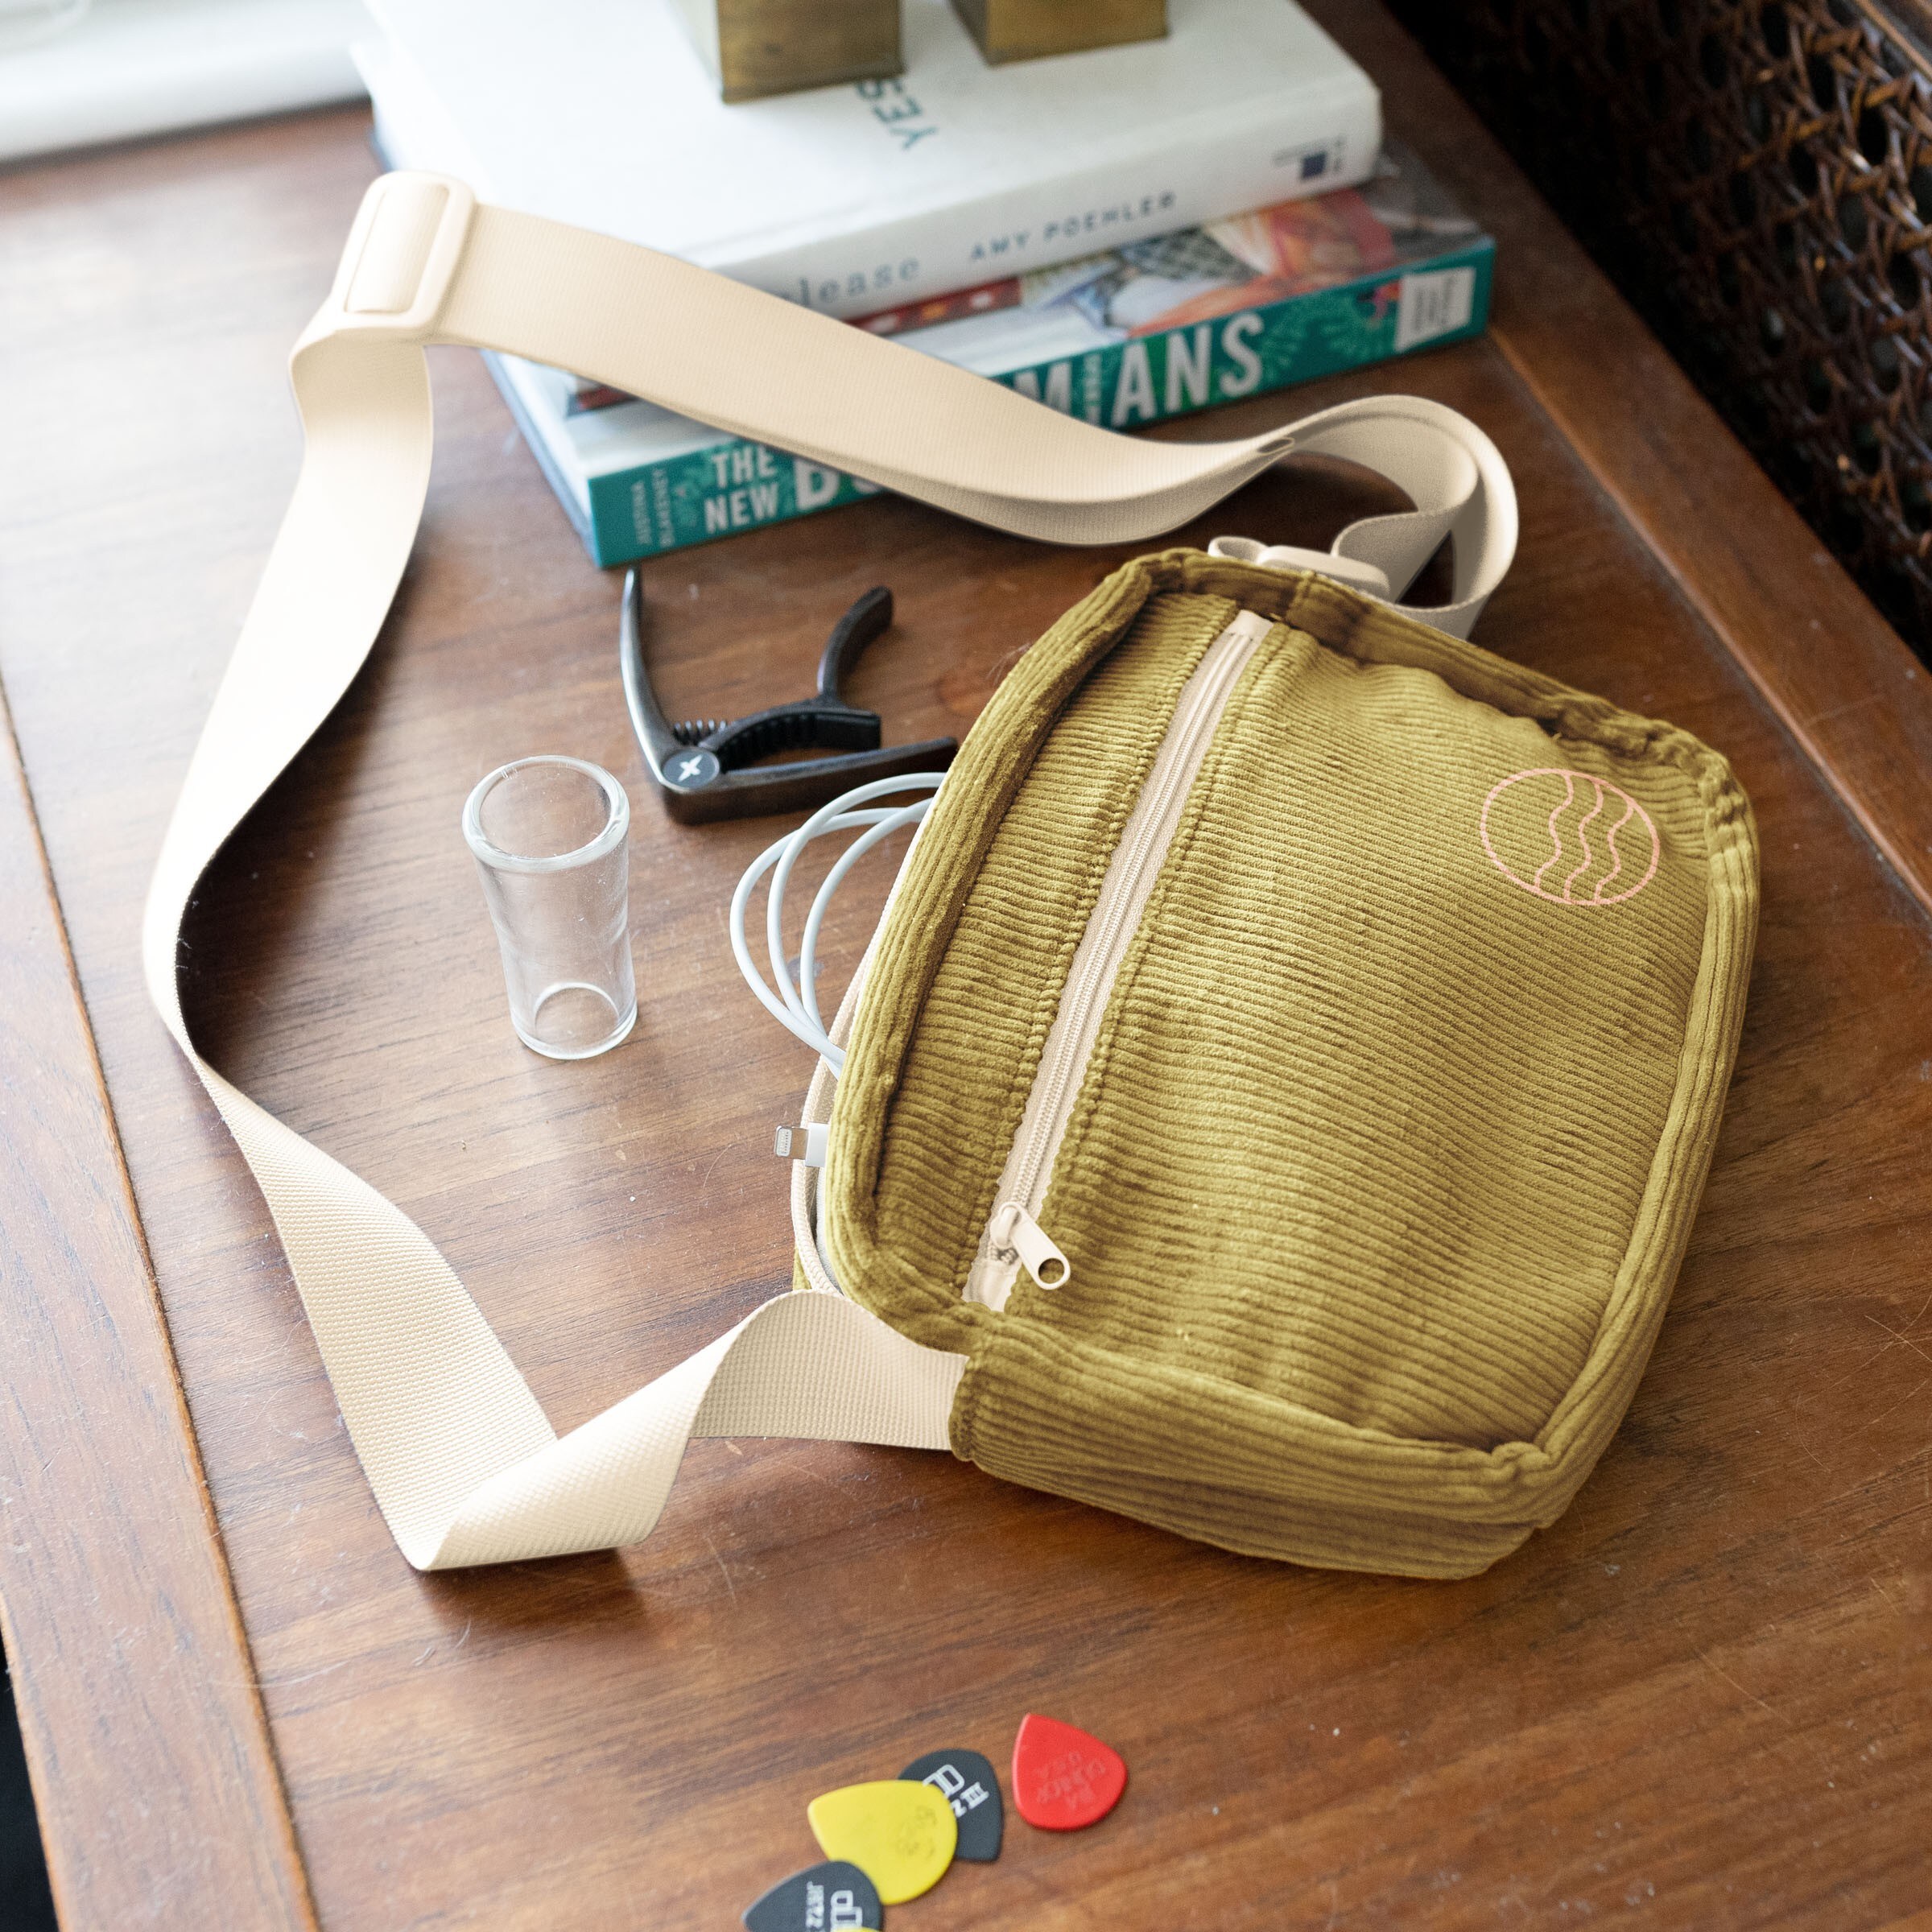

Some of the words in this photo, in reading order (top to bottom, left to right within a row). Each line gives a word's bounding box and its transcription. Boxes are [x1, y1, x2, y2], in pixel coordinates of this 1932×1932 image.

[780, 257, 920, 305] lease
[971, 233, 1030, 260] AMY
[1044, 191, 1176, 242] POEHLER
[711, 444, 779, 489] THE
[704, 483, 778, 535] NEW
